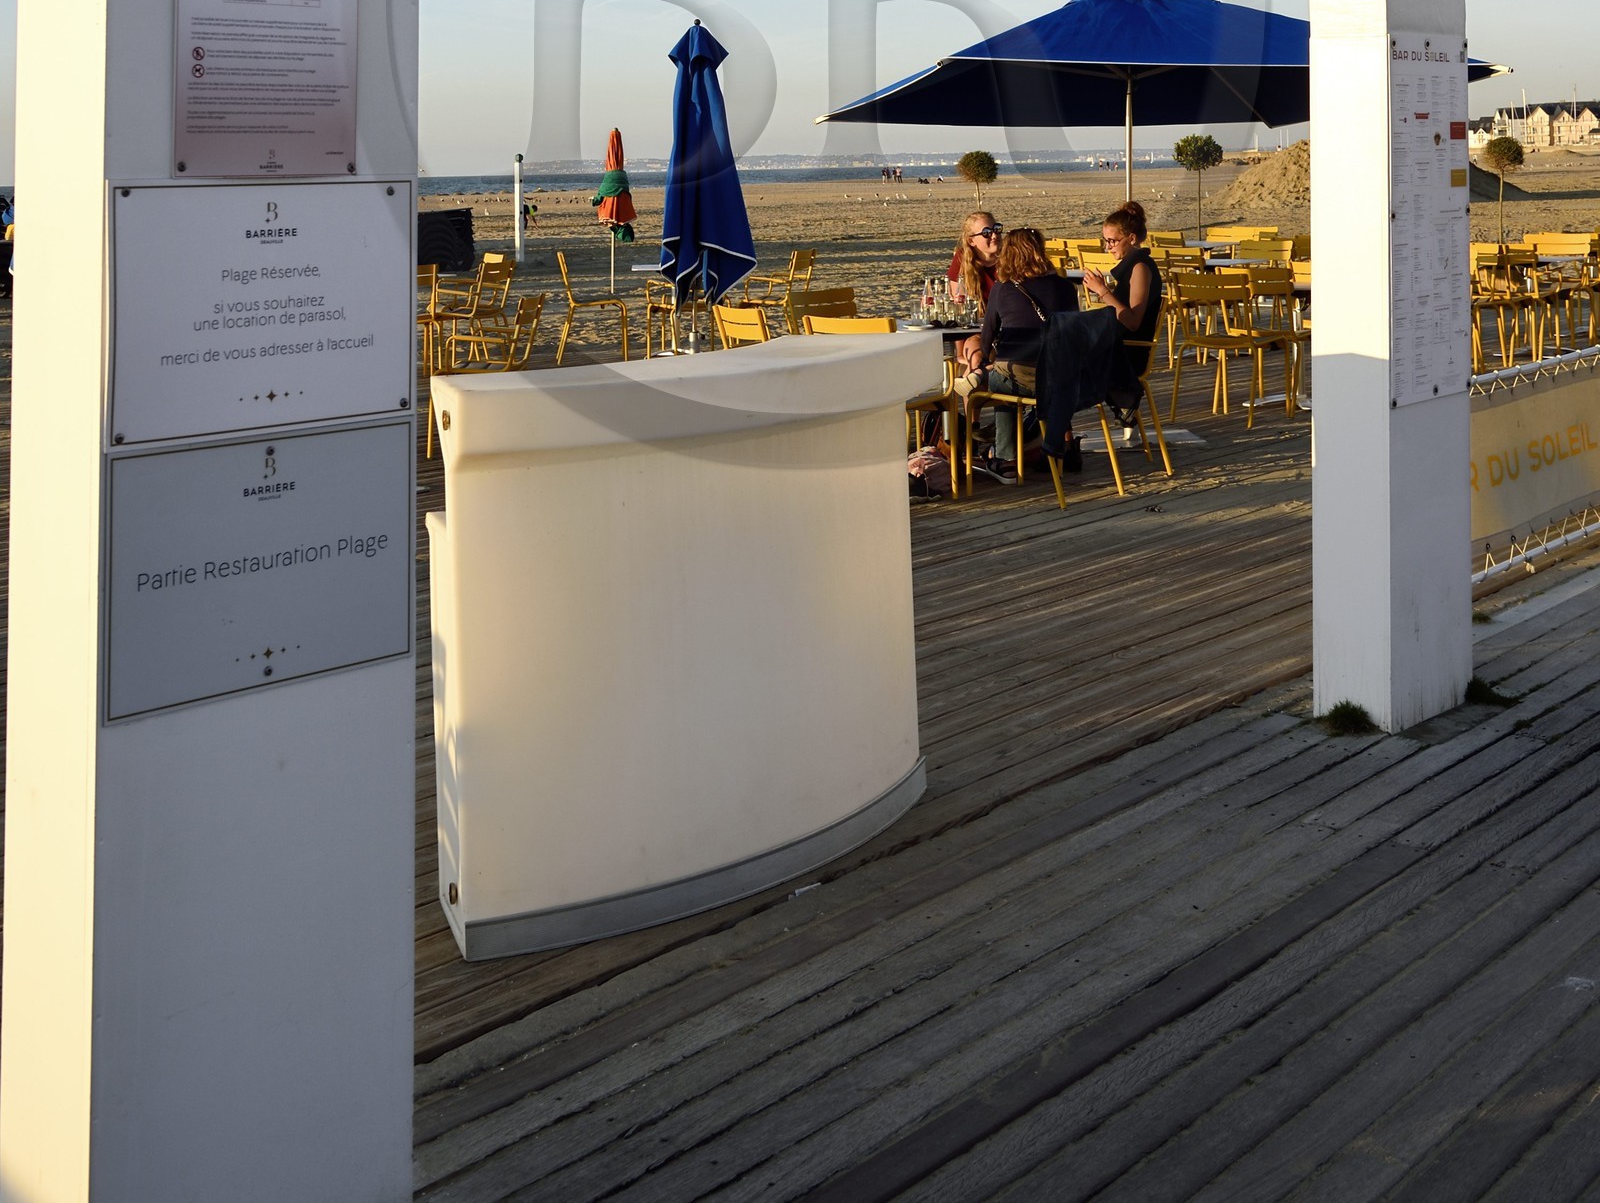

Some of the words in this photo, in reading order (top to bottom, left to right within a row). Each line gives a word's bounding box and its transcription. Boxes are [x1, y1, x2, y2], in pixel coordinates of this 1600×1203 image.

[1392, 50, 1409, 61] BAR
[1411, 51, 1422, 62] DU
[221, 269, 258, 285] Plage
[213, 301, 224, 314] si
[227, 300, 260, 313] vous
[263, 295, 325, 310] souhaitez
[193, 318, 220, 332] une
[222, 313, 277, 329] location
[279, 311, 297, 325] de
[299, 307, 347, 327] parasol,
[160, 352, 200, 367] merci
[202, 349, 221, 363] de
[223, 346, 257, 361] vous
[259, 341, 314, 358] adresser
[316, 338, 325, 352] à
[1487, 447, 1521, 488] DU
[1527, 421, 1599, 473] SOLEIL
[136, 564, 197, 593] Partie
[203, 544, 331, 580] Restauration
[336, 533, 389, 558] Plage
